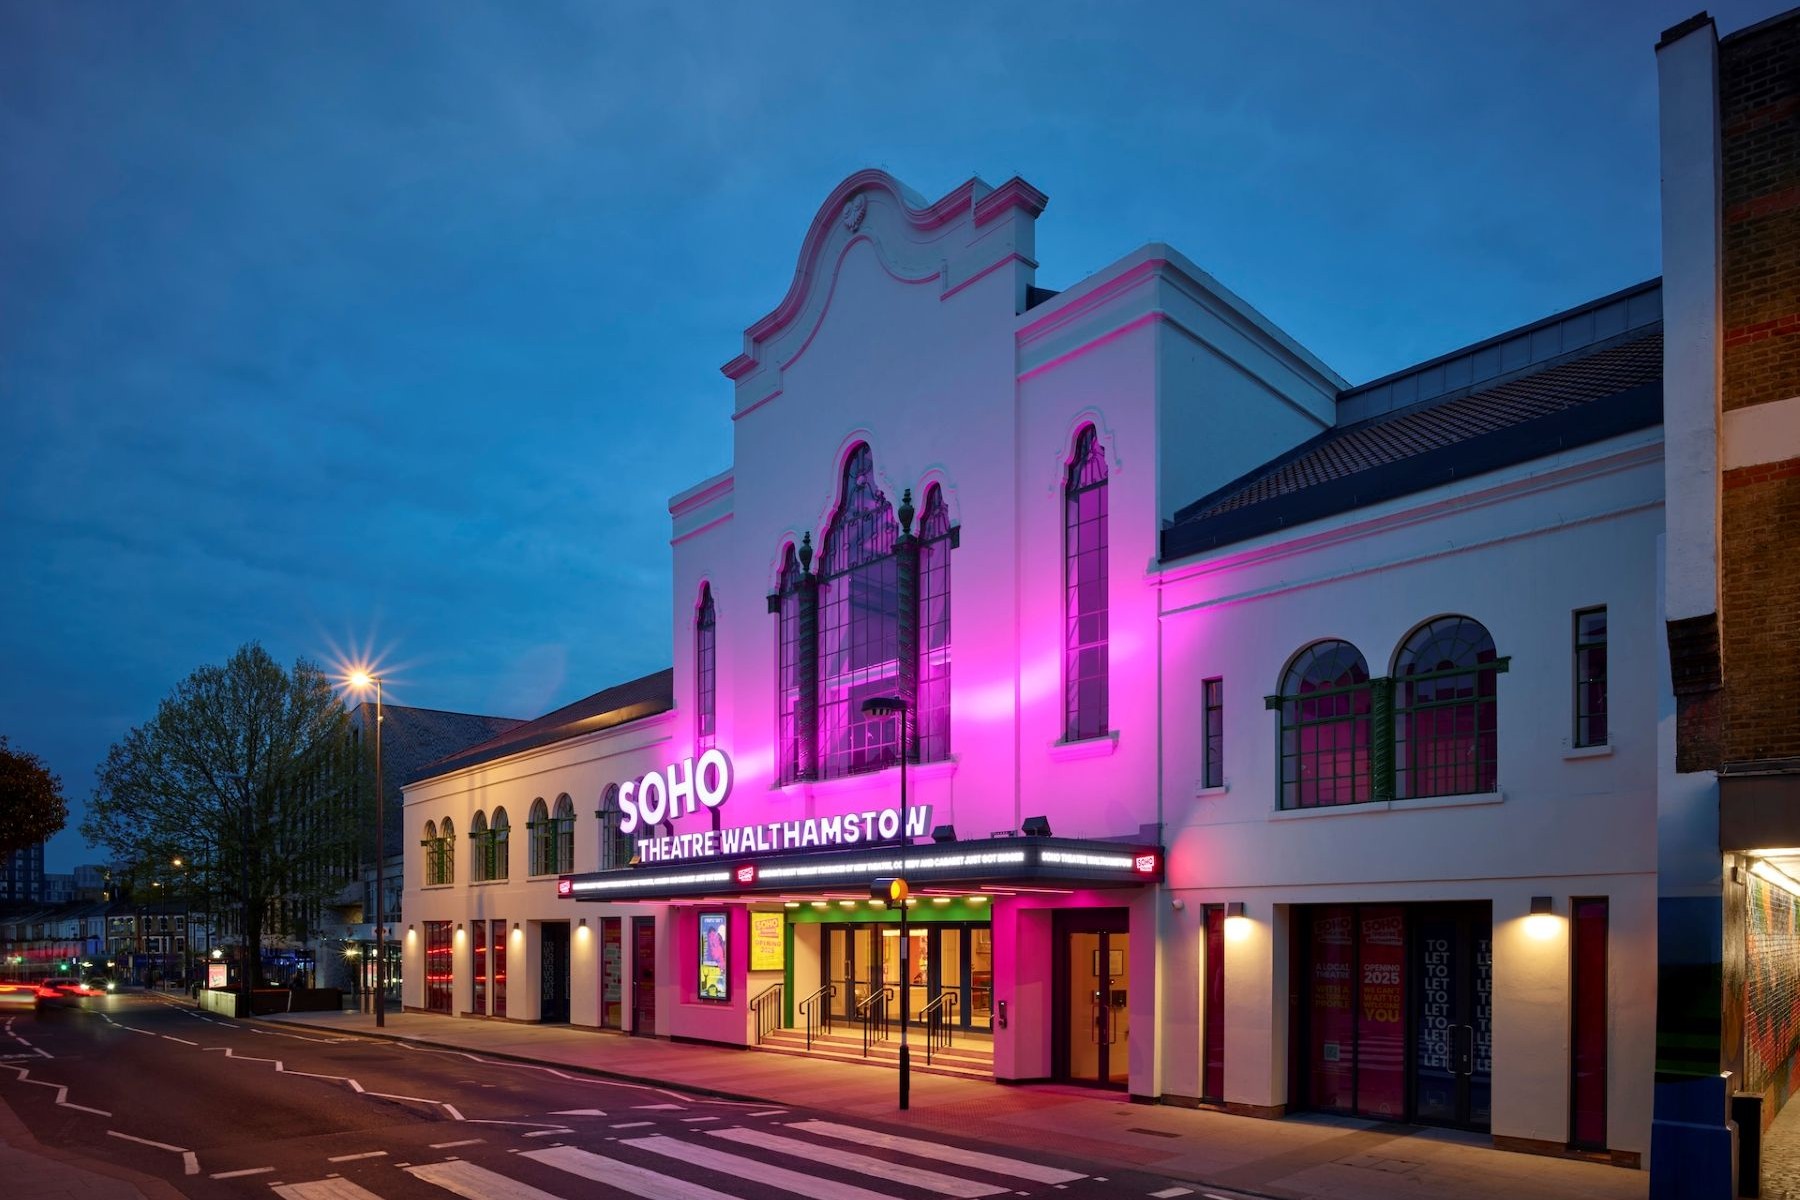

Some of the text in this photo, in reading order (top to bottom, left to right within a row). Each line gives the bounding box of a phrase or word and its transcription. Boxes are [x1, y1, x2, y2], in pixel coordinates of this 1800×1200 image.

[619, 749, 731, 833] SOHO
[638, 806, 928, 862] THEATRE WALTHAMSTOW
[982, 854, 996, 863] GOT
[756, 918, 778, 930] SOHO
[1364, 918, 1400, 932] SOHO
[1426, 940, 1448, 951] TO
[1478, 940, 1491, 951] T
[1425, 952, 1450, 964] LET
[1477, 953, 1491, 964] LE
[1426, 965, 1448, 977] TO
[1478, 966, 1491, 978] T
[1364, 972, 1400, 984] 2025
[1425, 978, 1450, 990] LET
[1477, 979, 1491, 991] LE
[1426, 991, 1447, 1003] TO
[1478, 992, 1491, 1004] T
[1365, 1009, 1399, 1022] YOU
[1425, 1004, 1450, 1016] LET
[1477, 1005, 1491, 1018] LE
[1425, 1016, 1447, 1029] TO
[1478, 1019, 1491, 1031] T
[1424, 1030, 1448, 1042] LET
[1477, 1032, 1491, 1044] LE
[1425, 1043, 1446, 1054] TO
[1478, 1046, 1491, 1058] T
[1424, 1055, 1447, 1067] LET
[1477, 1059, 1491, 1071] LE
